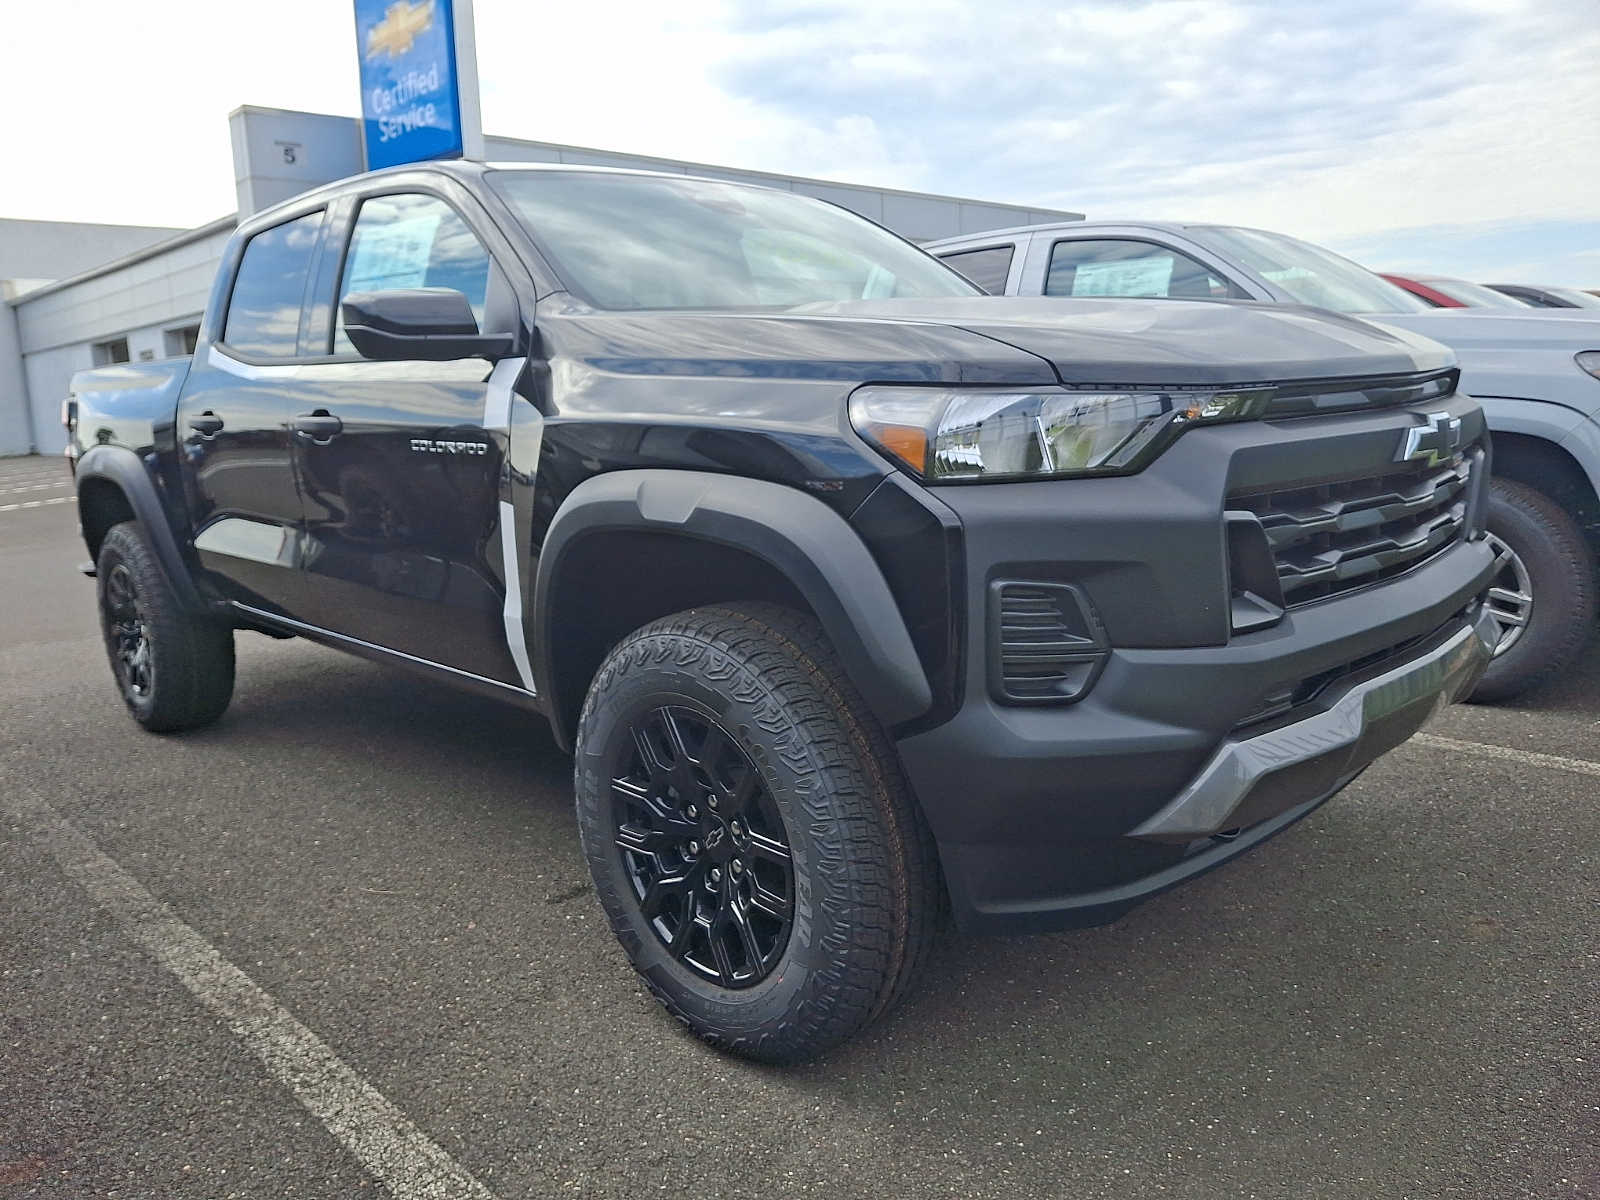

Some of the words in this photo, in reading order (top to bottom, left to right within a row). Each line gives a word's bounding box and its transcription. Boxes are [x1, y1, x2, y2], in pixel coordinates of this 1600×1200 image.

[371, 61, 439, 114] Certified
[379, 103, 436, 142] Service
[283, 148, 296, 164] 5
[410, 439, 488, 455] COLORADO
